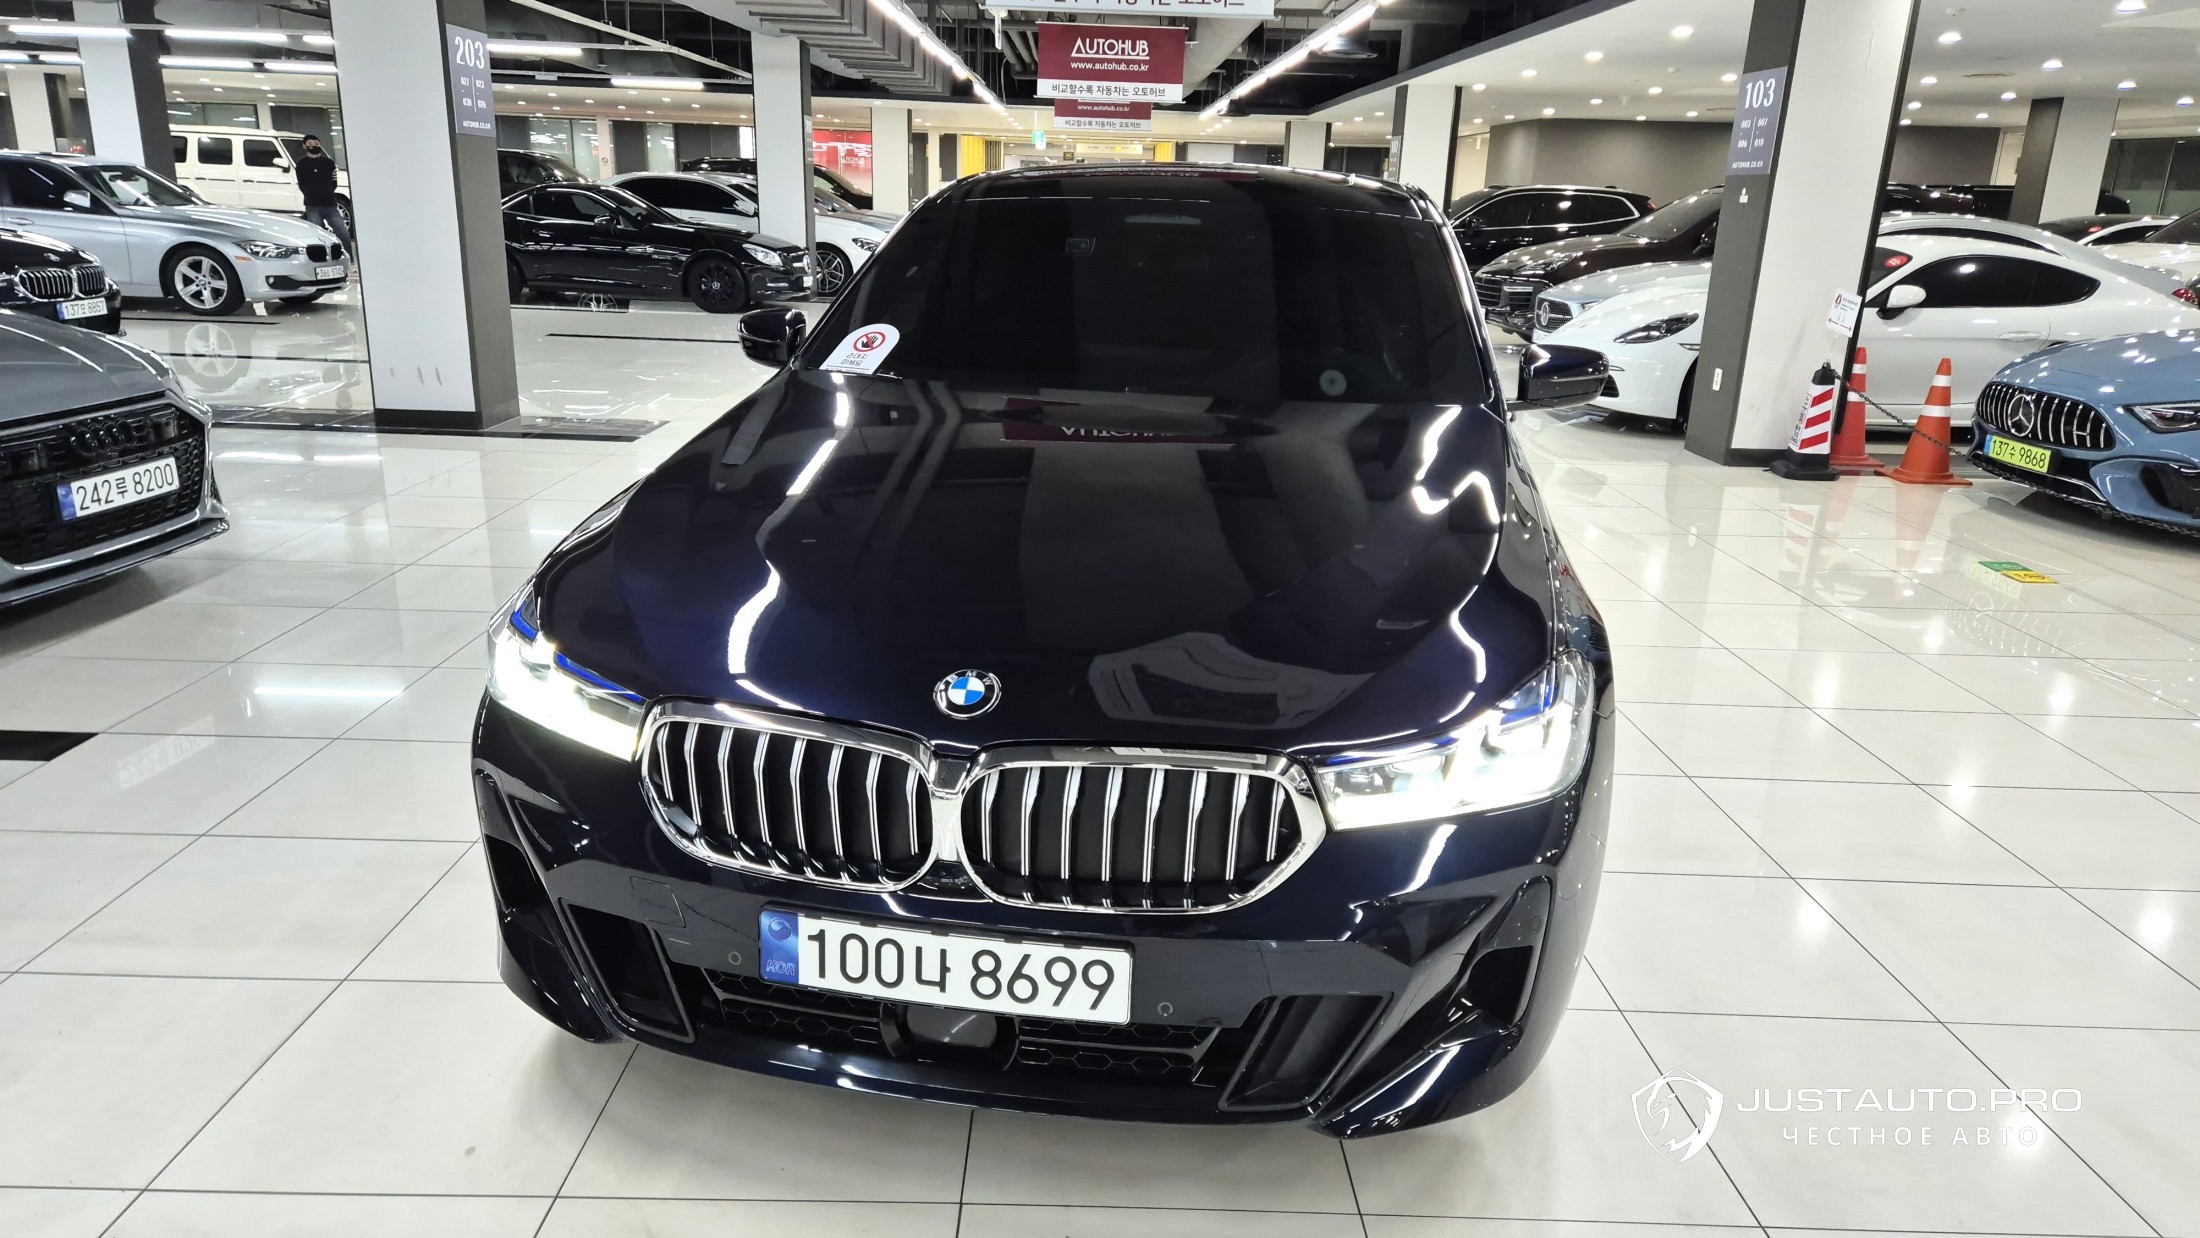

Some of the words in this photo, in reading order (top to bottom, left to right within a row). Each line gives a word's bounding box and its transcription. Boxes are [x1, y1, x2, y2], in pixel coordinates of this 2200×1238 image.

[454, 36, 485, 69] 203
[1071, 37, 1150, 59] AUTOHUB
[1071, 61, 1150, 72] www.autohub.co.kr
[1052, 83, 1094, 95] 비교할수록
[1096, 85, 1130, 96] 자동차는
[1132, 87, 1166, 98] 오토허브
[1744, 78, 1776, 109] 103
[1992, 439, 2016, 459] 137수
[2019, 447, 2046, 468] 9868
[76, 476, 129, 512] 242루
[132, 462, 175, 496] 8200
[946, 670, 994, 686] BMW
[766, 959, 796, 976] KOR
[807, 928, 952, 994] 100나
[969, 949, 1115, 1012] 8699
